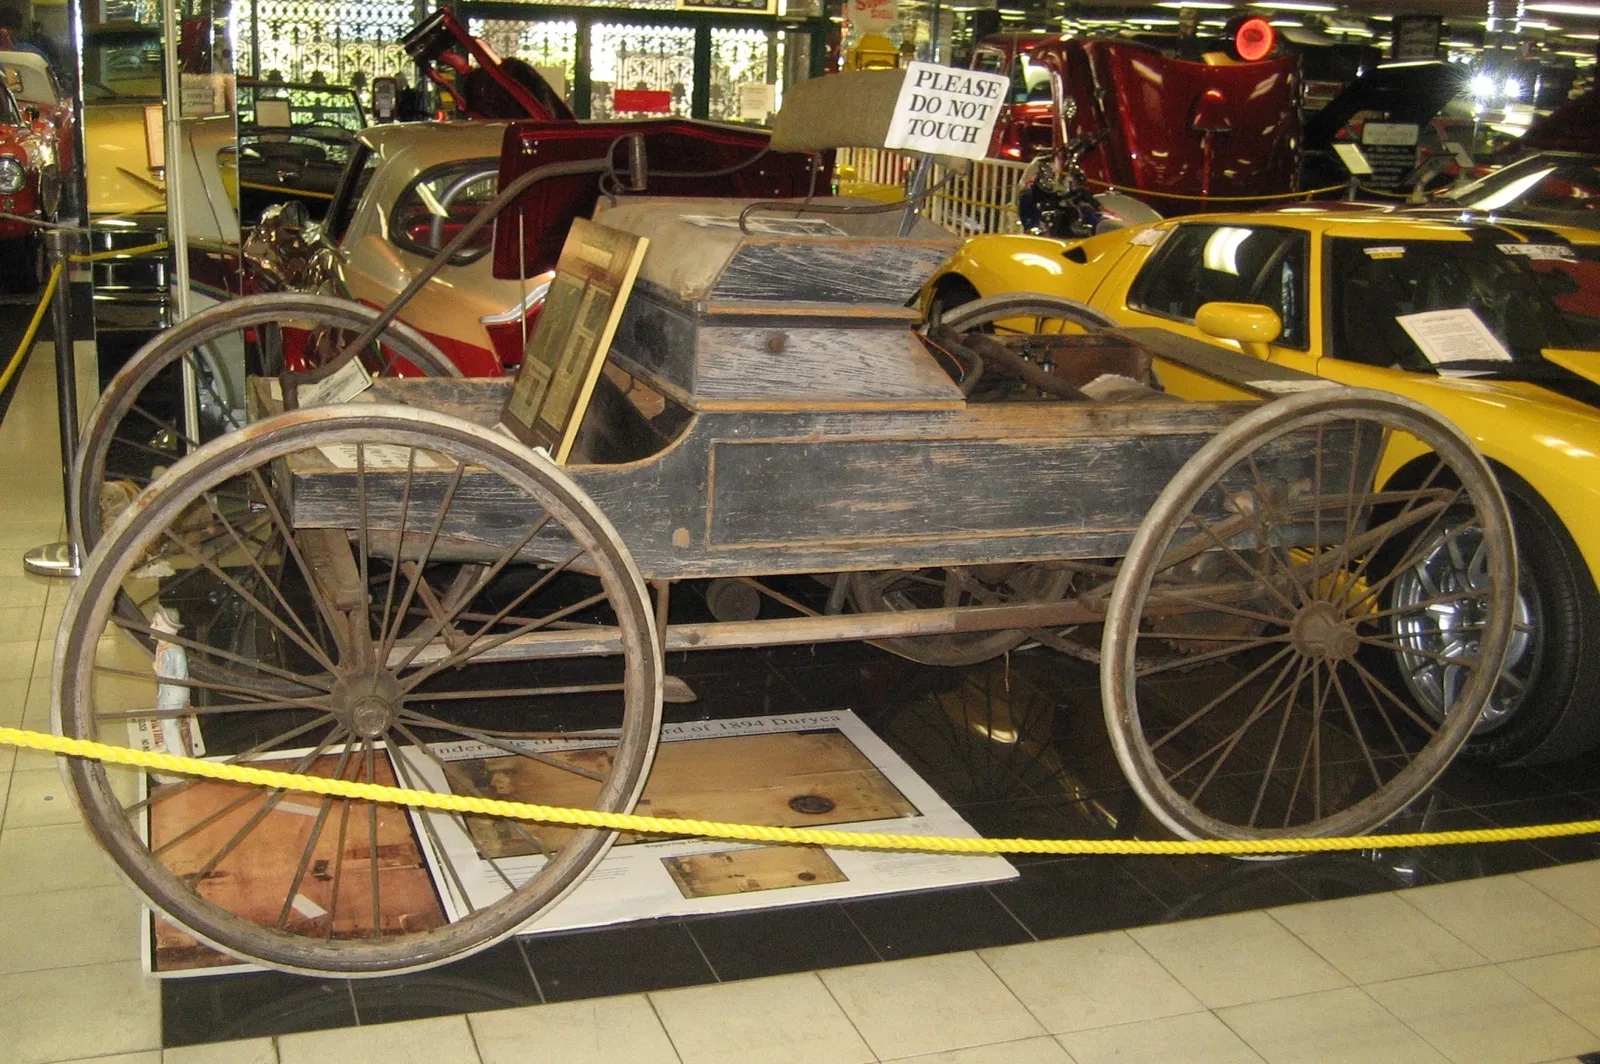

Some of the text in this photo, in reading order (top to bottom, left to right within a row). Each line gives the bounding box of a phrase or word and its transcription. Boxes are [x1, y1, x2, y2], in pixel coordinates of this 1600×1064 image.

[913, 69, 1002, 100] PLEASE
[908, 93, 993, 121] DO NOT
[908, 118, 981, 144] TOUCH
[691, 723, 712, 732] of
[719, 718, 765, 731] 1894
[771, 714, 842, 727] Duryea
